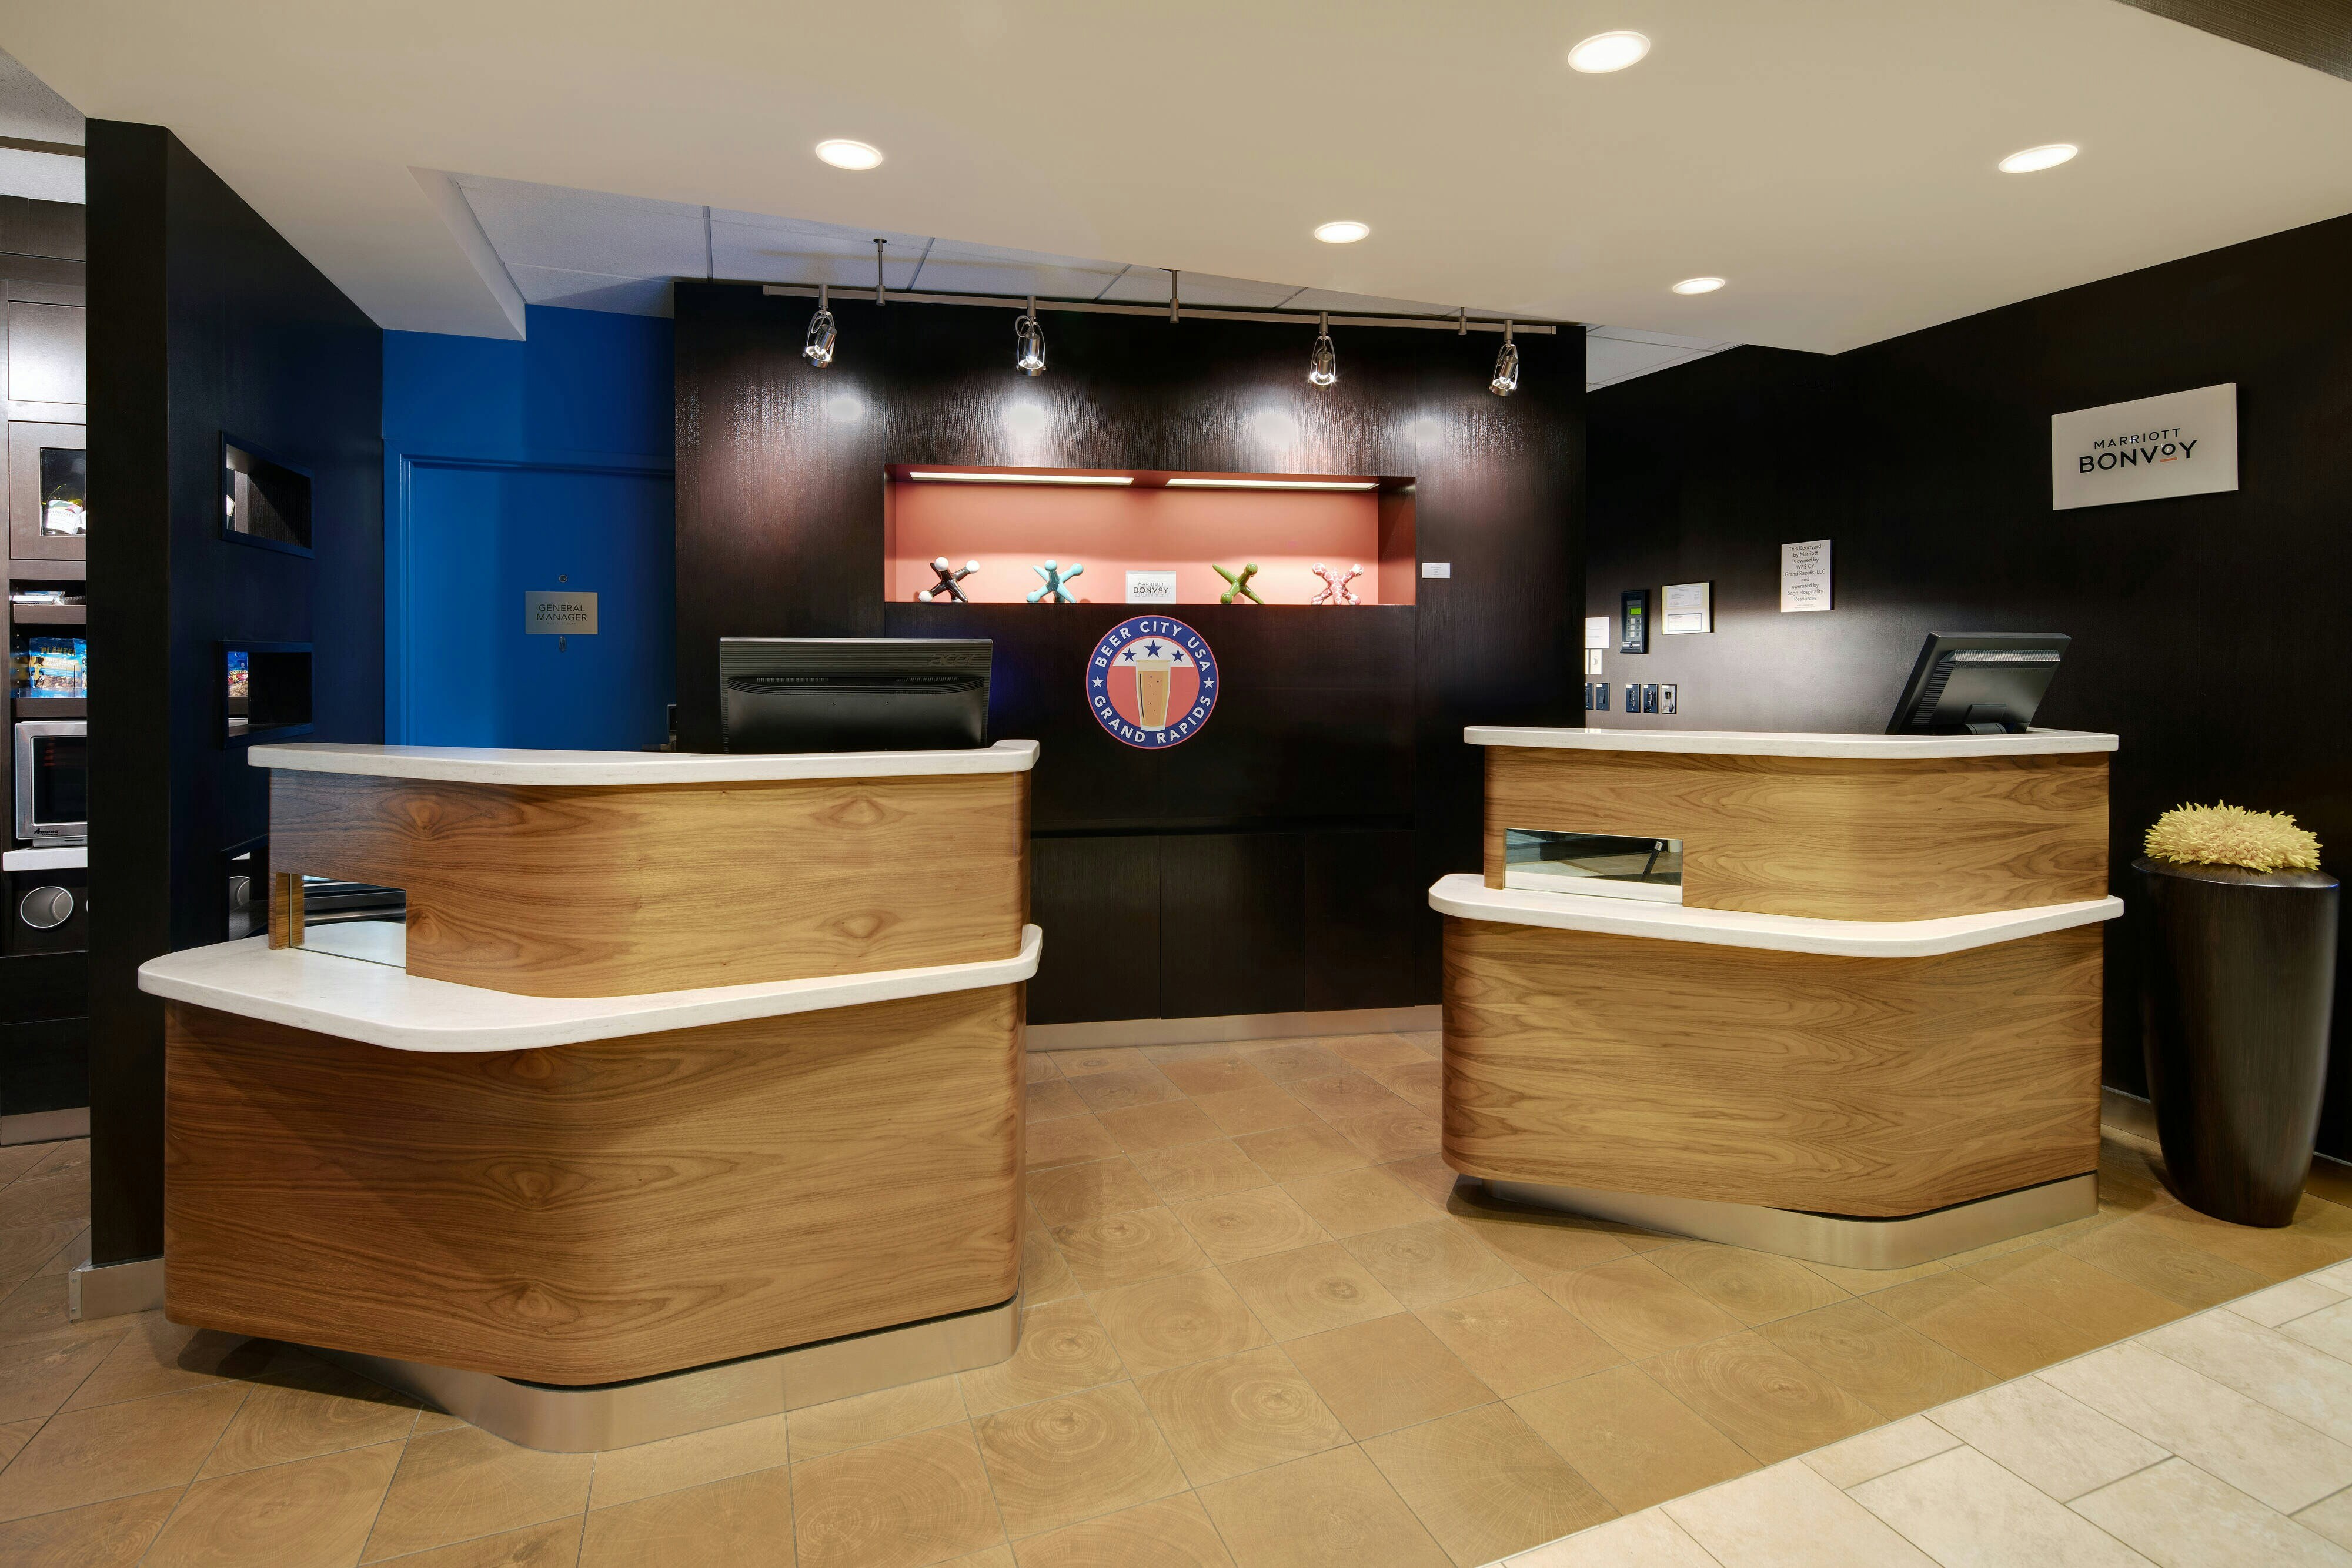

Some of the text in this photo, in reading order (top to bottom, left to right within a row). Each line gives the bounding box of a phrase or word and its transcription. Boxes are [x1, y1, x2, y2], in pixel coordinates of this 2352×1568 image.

[2094, 427, 2181, 450] MARRIOTT
[2079, 439, 2198, 474] BONVOY
[539, 604, 585, 612] GENERAL
[1095, 621, 1211, 672] BEER CITY USA
[1094, 696, 1211, 744] GRAND RAPIDS
